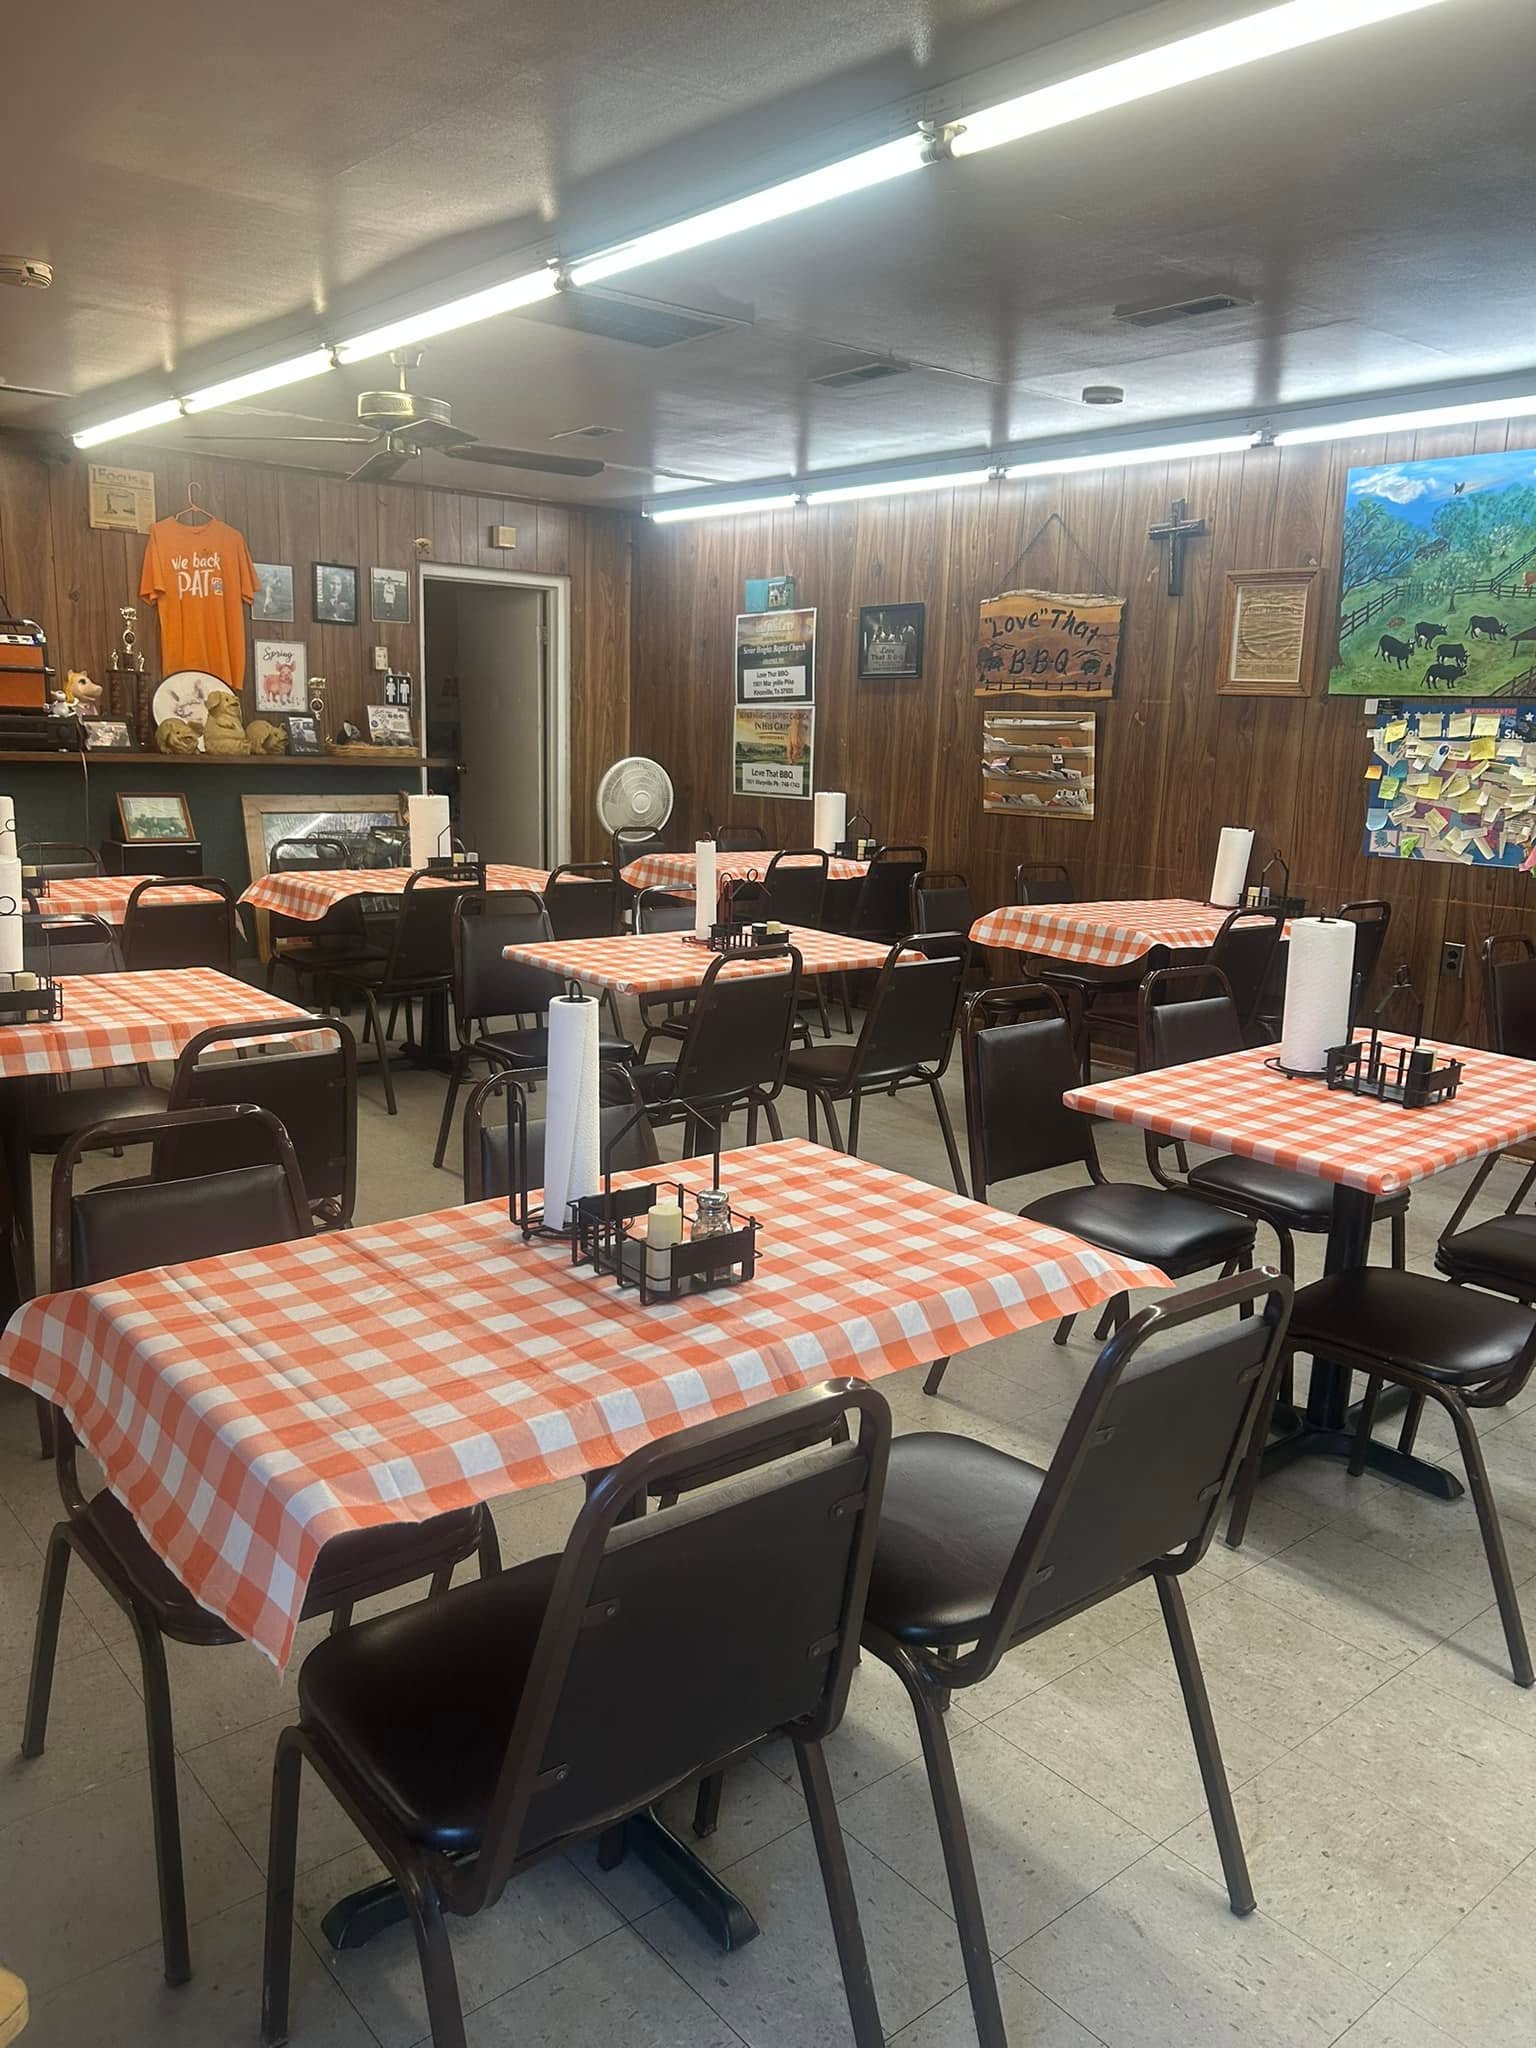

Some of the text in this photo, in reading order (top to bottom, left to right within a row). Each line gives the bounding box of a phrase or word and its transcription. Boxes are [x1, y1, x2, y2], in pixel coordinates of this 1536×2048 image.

[193, 552, 221, 570] back
[177, 569, 215, 600] PAT
[1051, 609, 1099, 646] That
[263, 646, 294, 663] Spring
[751, 768, 793, 779] Love That BBQ
